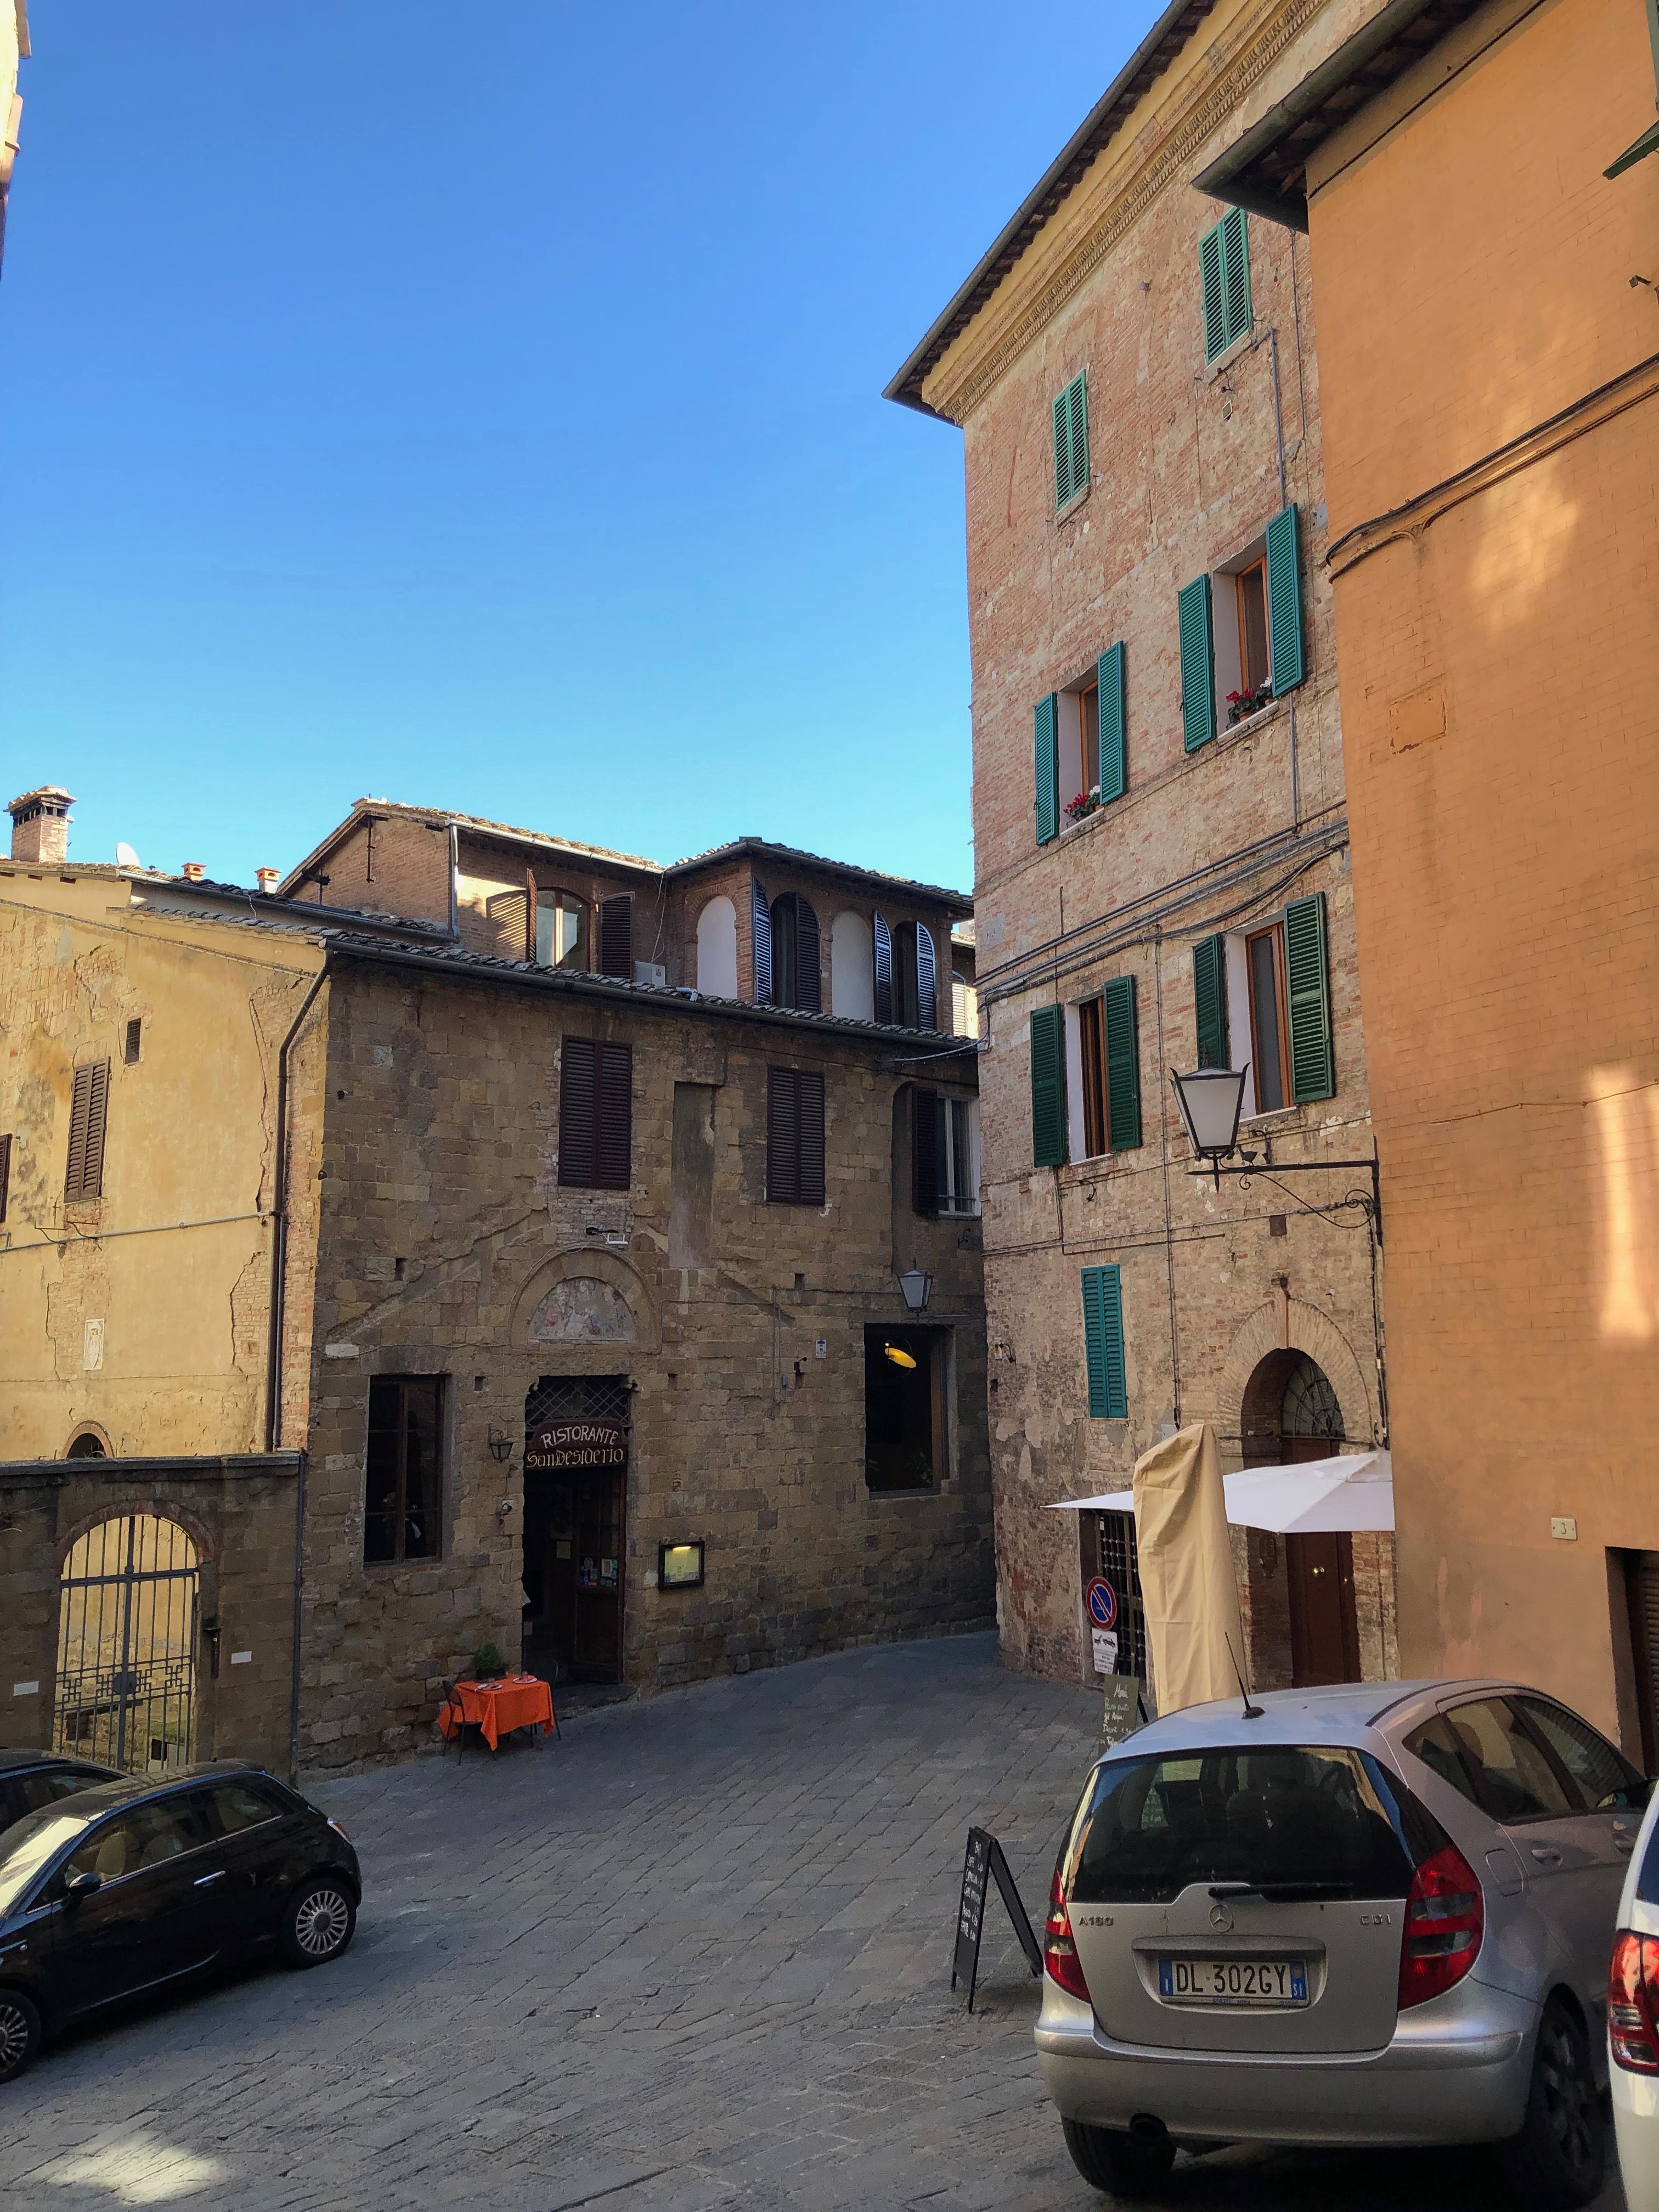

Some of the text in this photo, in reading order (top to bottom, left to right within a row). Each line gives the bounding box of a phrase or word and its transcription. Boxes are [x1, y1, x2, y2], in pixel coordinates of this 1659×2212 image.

[540, 1425, 619, 1449] RISTORANTE
[1560, 1522, 1567, 1535] 3
[1360, 1914, 1391, 1926] CDI
[1293, 1983, 1303, 1997] SI
